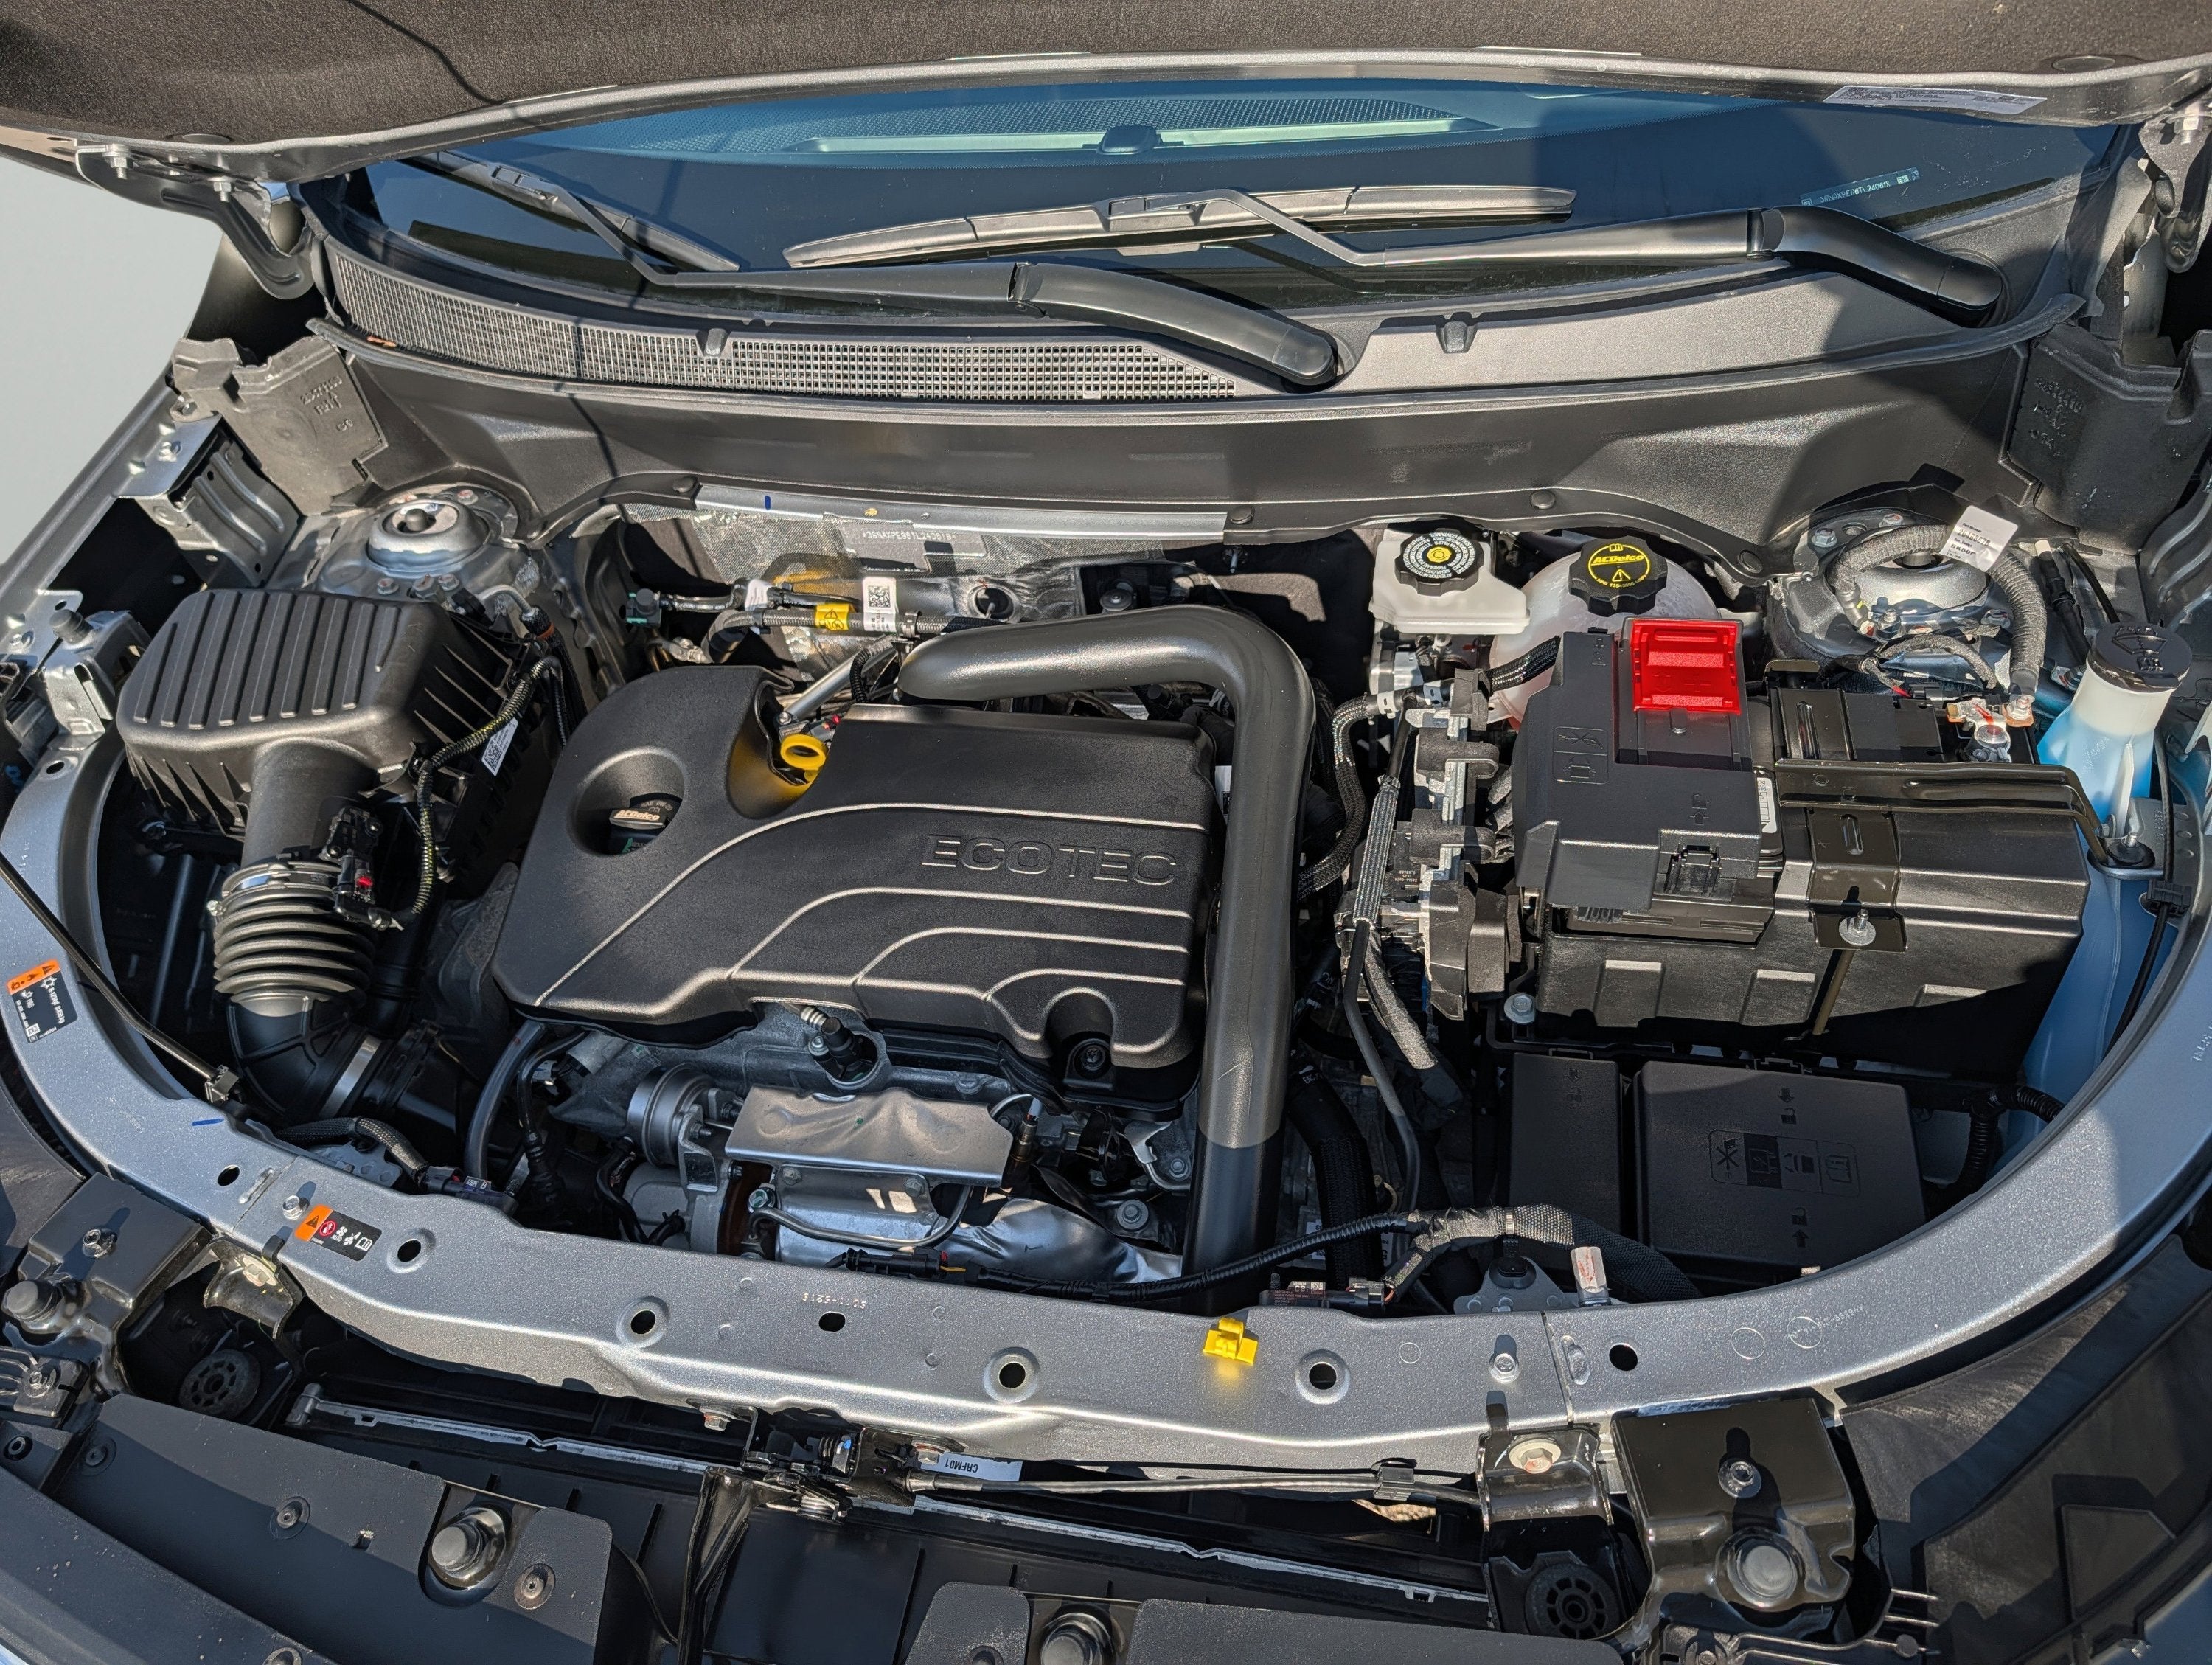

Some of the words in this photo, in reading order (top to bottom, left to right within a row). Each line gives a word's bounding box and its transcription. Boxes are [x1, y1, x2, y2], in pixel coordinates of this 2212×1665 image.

[1593, 555, 1644, 563] ACDelco
[613, 810, 661, 821] ACDelco
[921, 833, 1177, 886] ECOTEC
[945, 1459, 979, 1473] CRFM01
